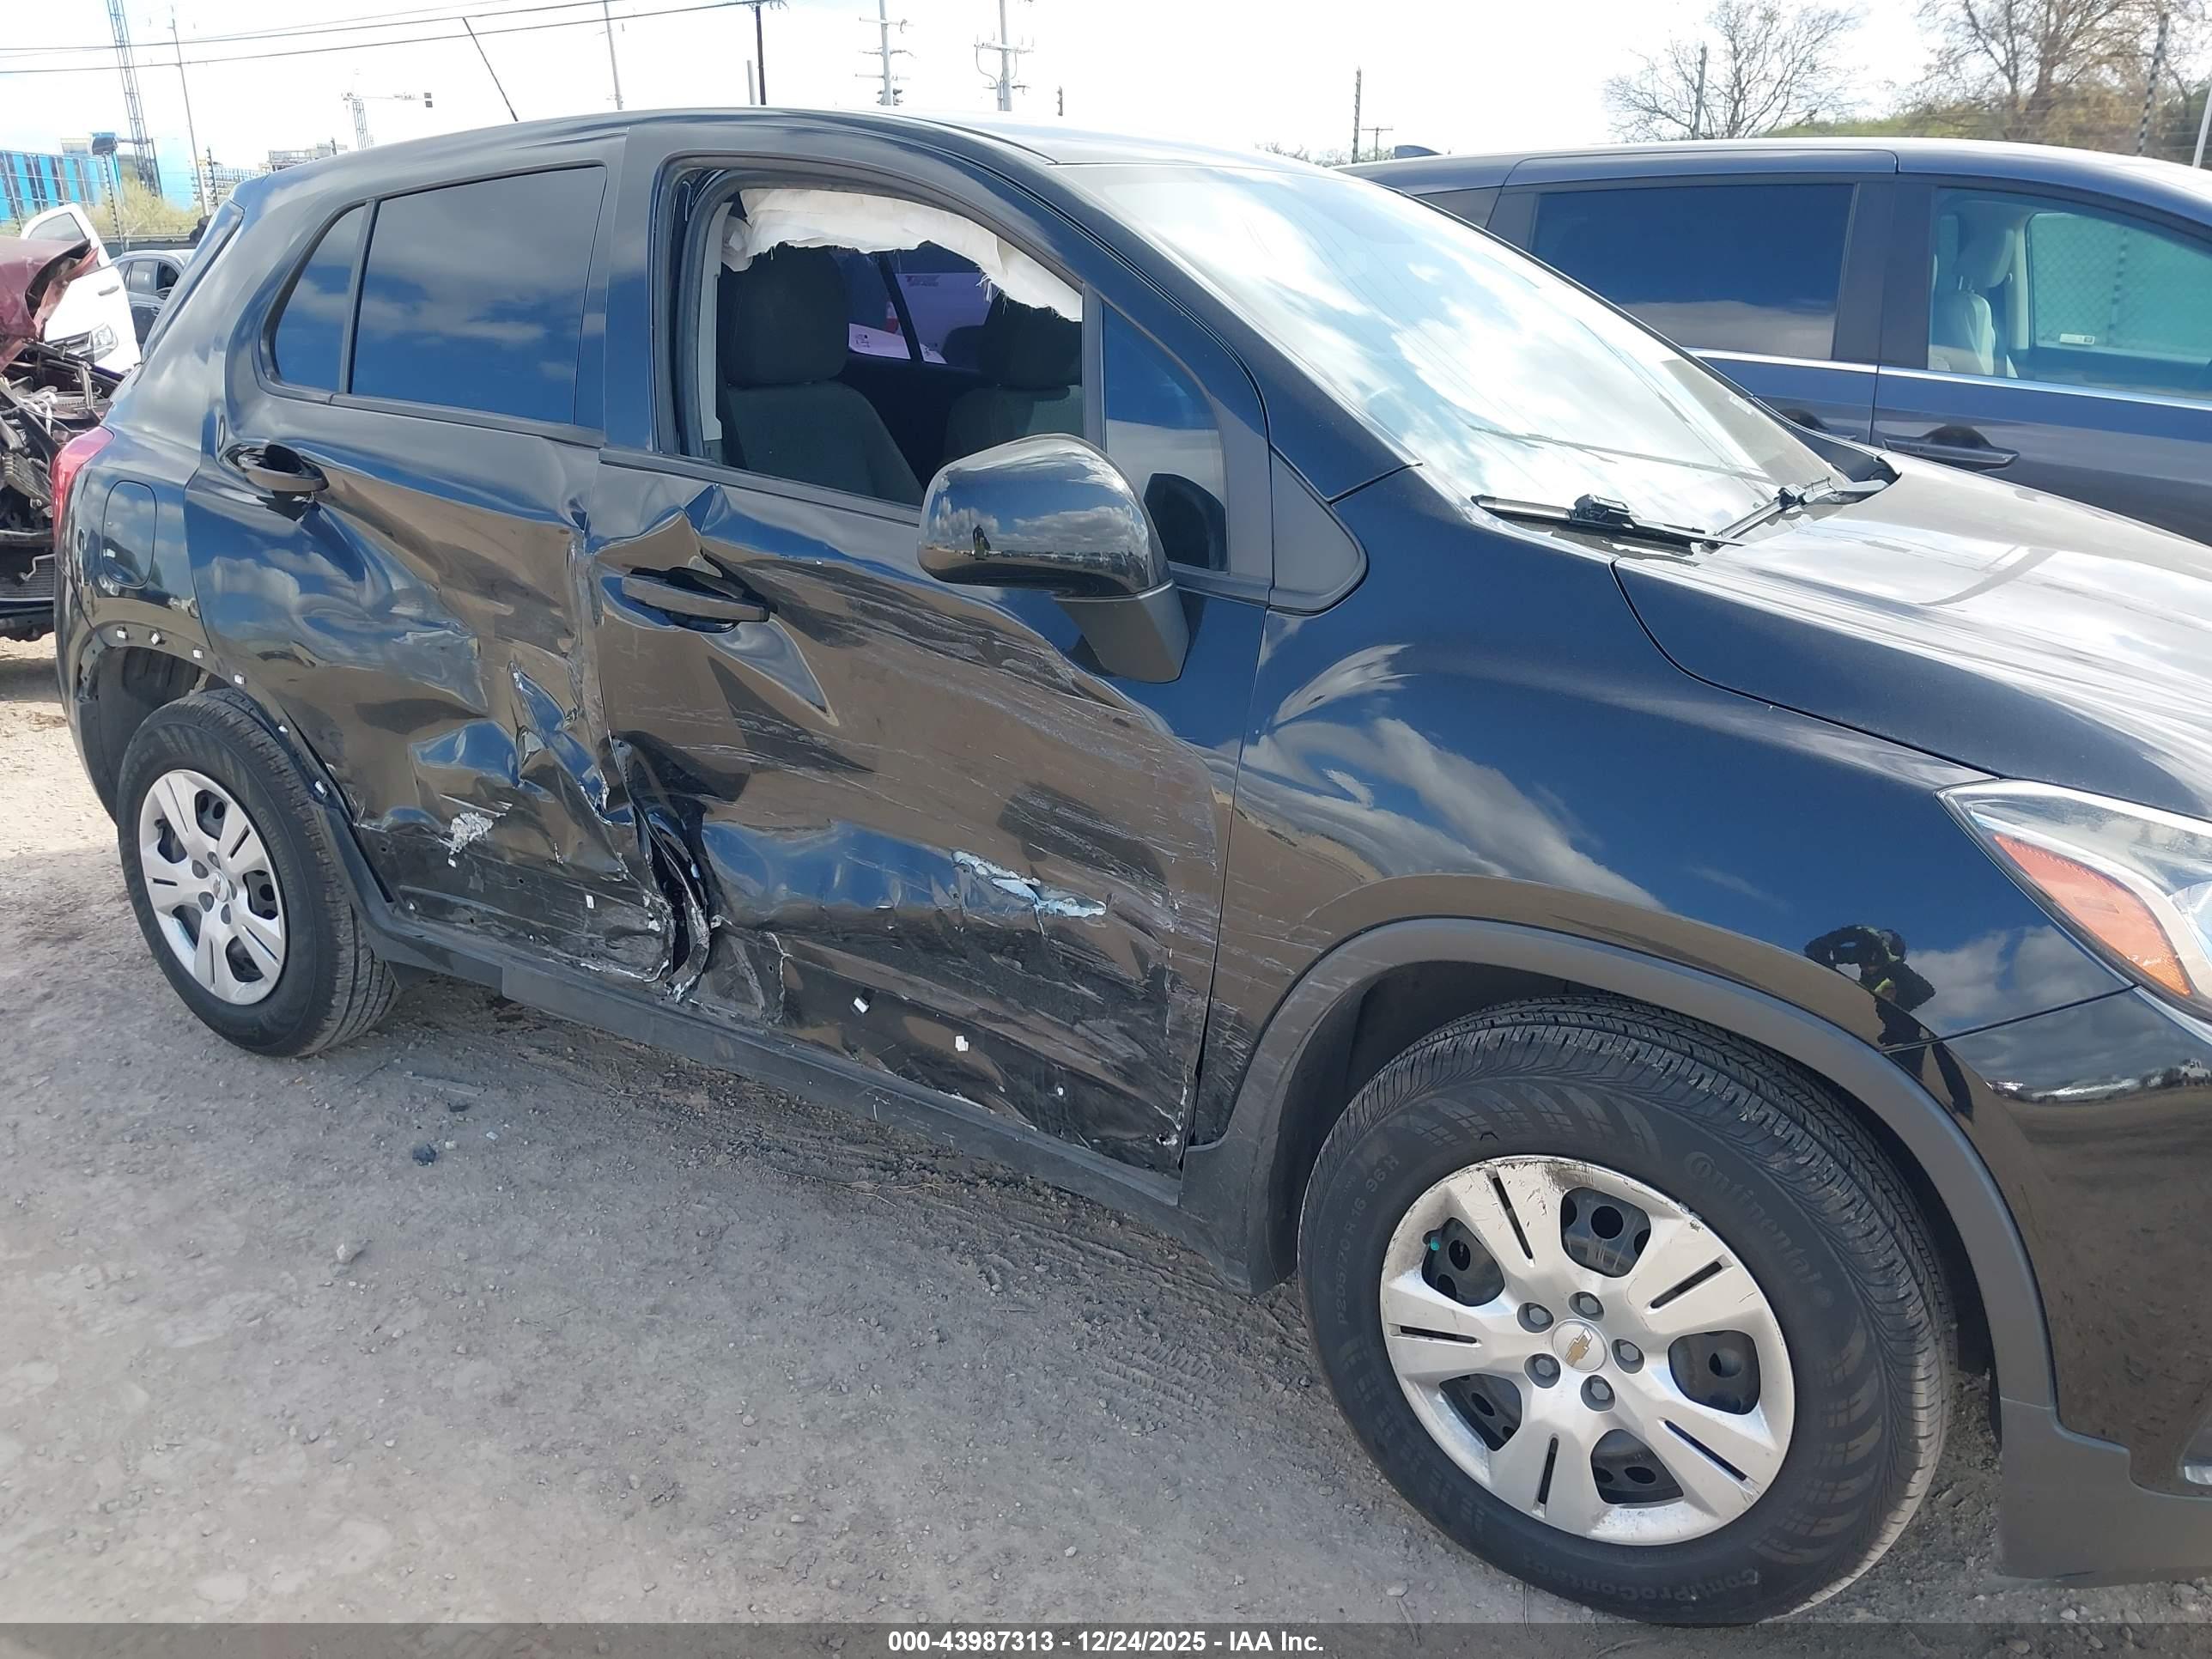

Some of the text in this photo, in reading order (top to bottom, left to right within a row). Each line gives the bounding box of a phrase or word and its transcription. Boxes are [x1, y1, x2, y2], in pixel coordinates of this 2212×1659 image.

[1351, 1196, 1367, 1217] 16
[1365, 1168, 1387, 1193] 96
[1383, 1154, 1401, 1171] H
[1683, 1151, 1823, 1285] Continental
